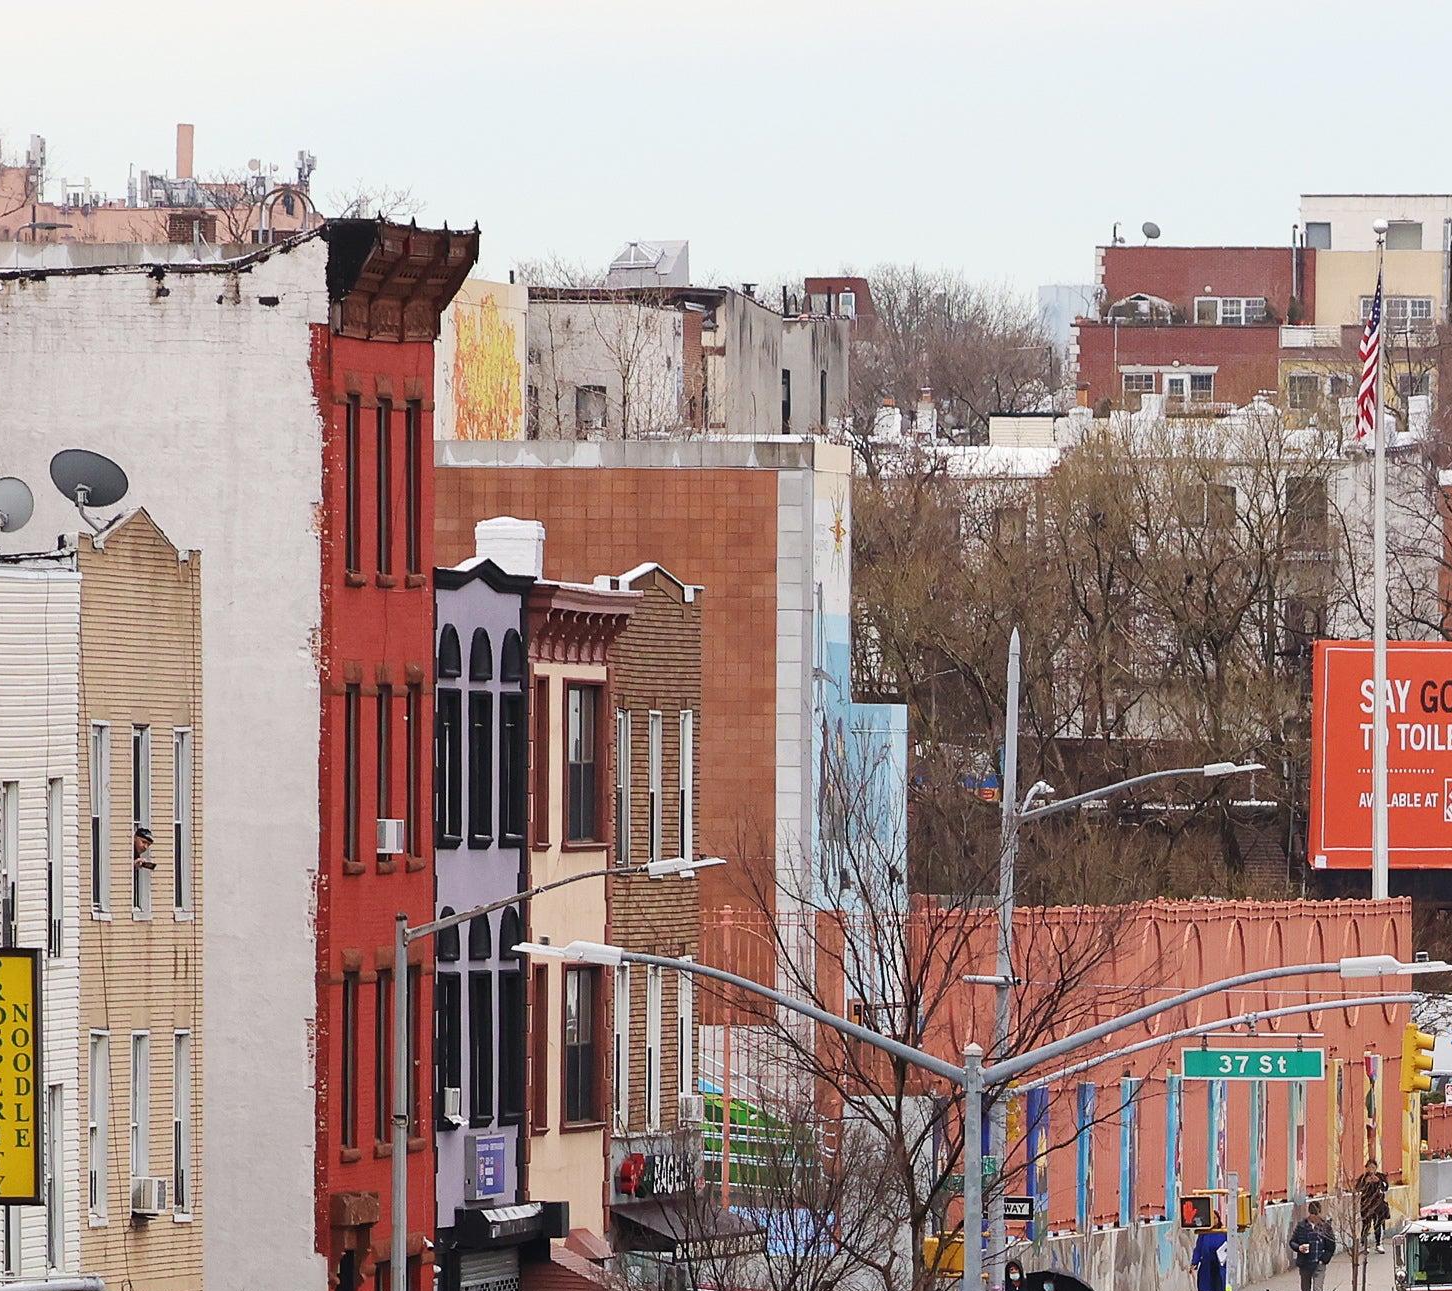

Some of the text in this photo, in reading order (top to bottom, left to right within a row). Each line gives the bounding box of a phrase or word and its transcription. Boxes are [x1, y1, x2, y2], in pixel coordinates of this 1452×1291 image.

[1359, 679, 1410, 714] SAY
[12, 1002, 31, 1148] NOODLE
[1219, 1054, 1288, 1075] 37 St
